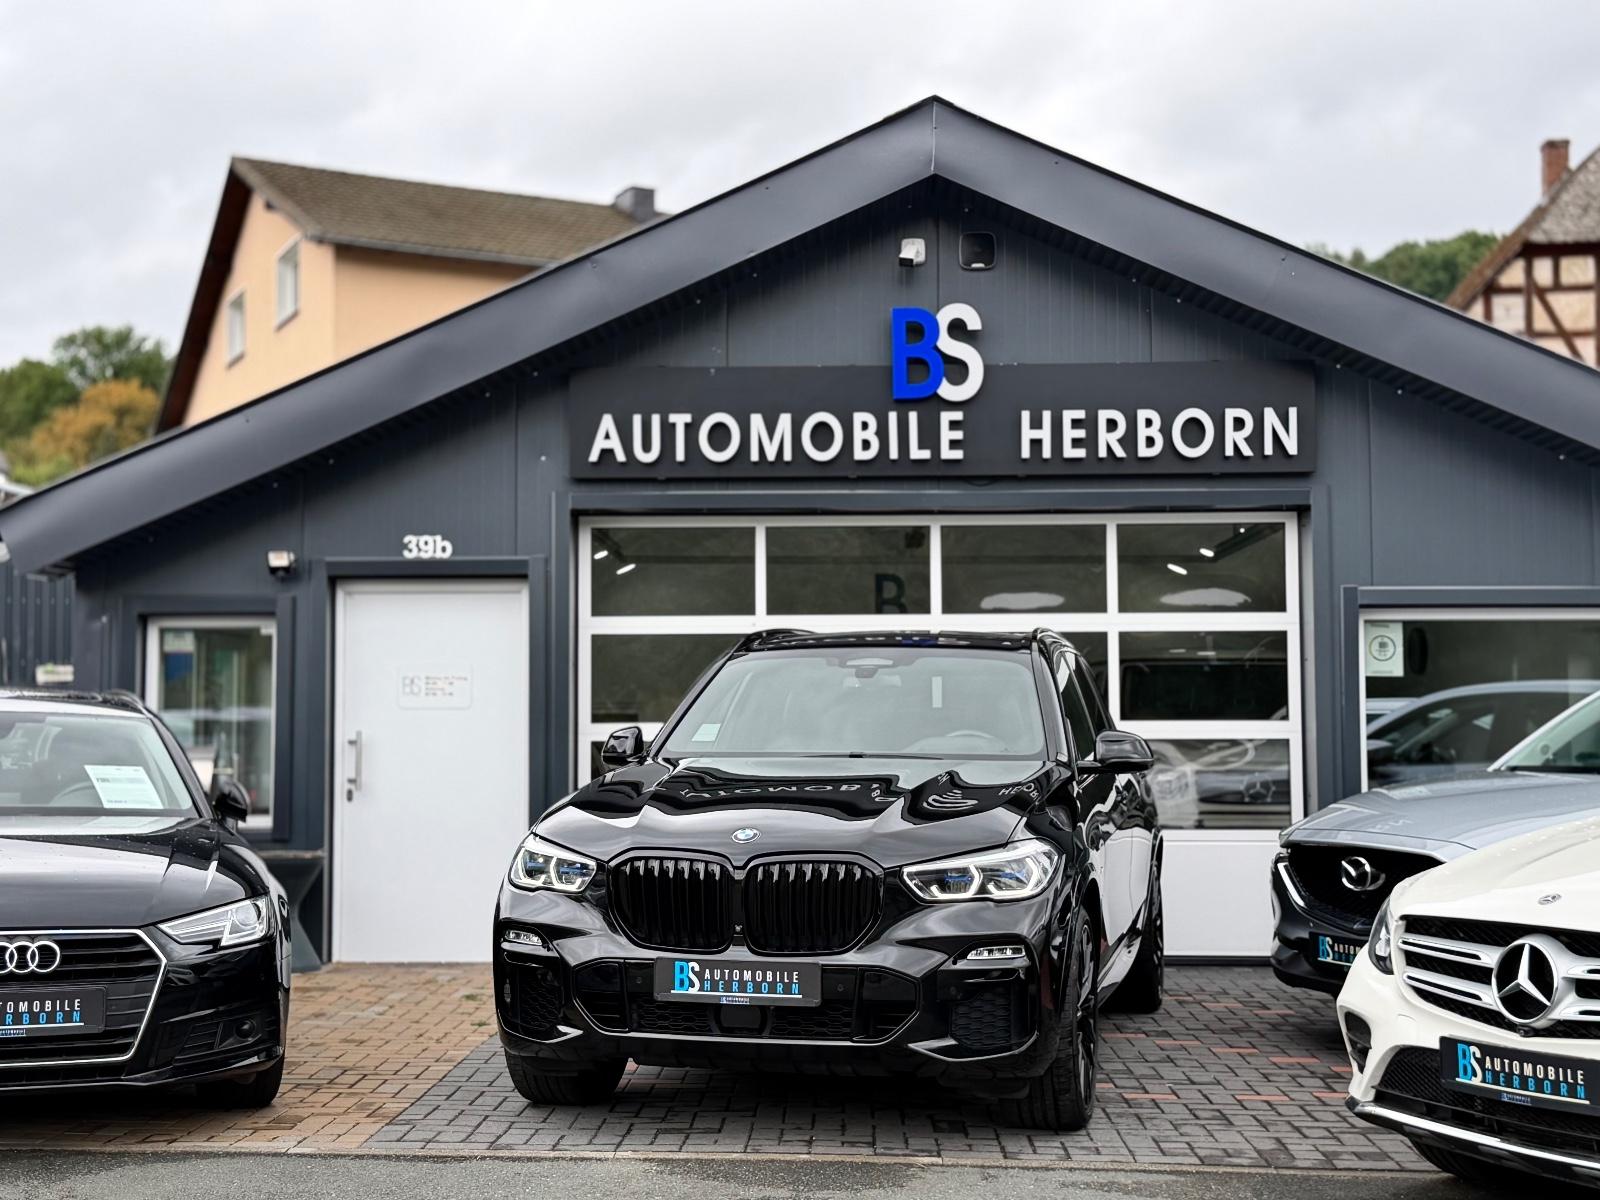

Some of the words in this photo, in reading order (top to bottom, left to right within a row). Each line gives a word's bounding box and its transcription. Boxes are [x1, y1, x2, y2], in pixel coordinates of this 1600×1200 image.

[891, 303, 985, 402] BS
[588, 410, 965, 463] AUTOMOBILE
[1020, 406, 1299, 459] HERBORN
[402, 534, 453, 559] 39b
[674, 961, 701, 992] BS
[704, 968, 799, 983] AUTOMOBILE
[704, 981, 799, 994] HERBORN
[5, 1010, 81, 1025] RBORN
[1457, 1043, 1483, 1083] BS
[1485, 1055, 1585, 1084] AUTOMOBILE
[1485, 1069, 1585, 1099] HERBORN
